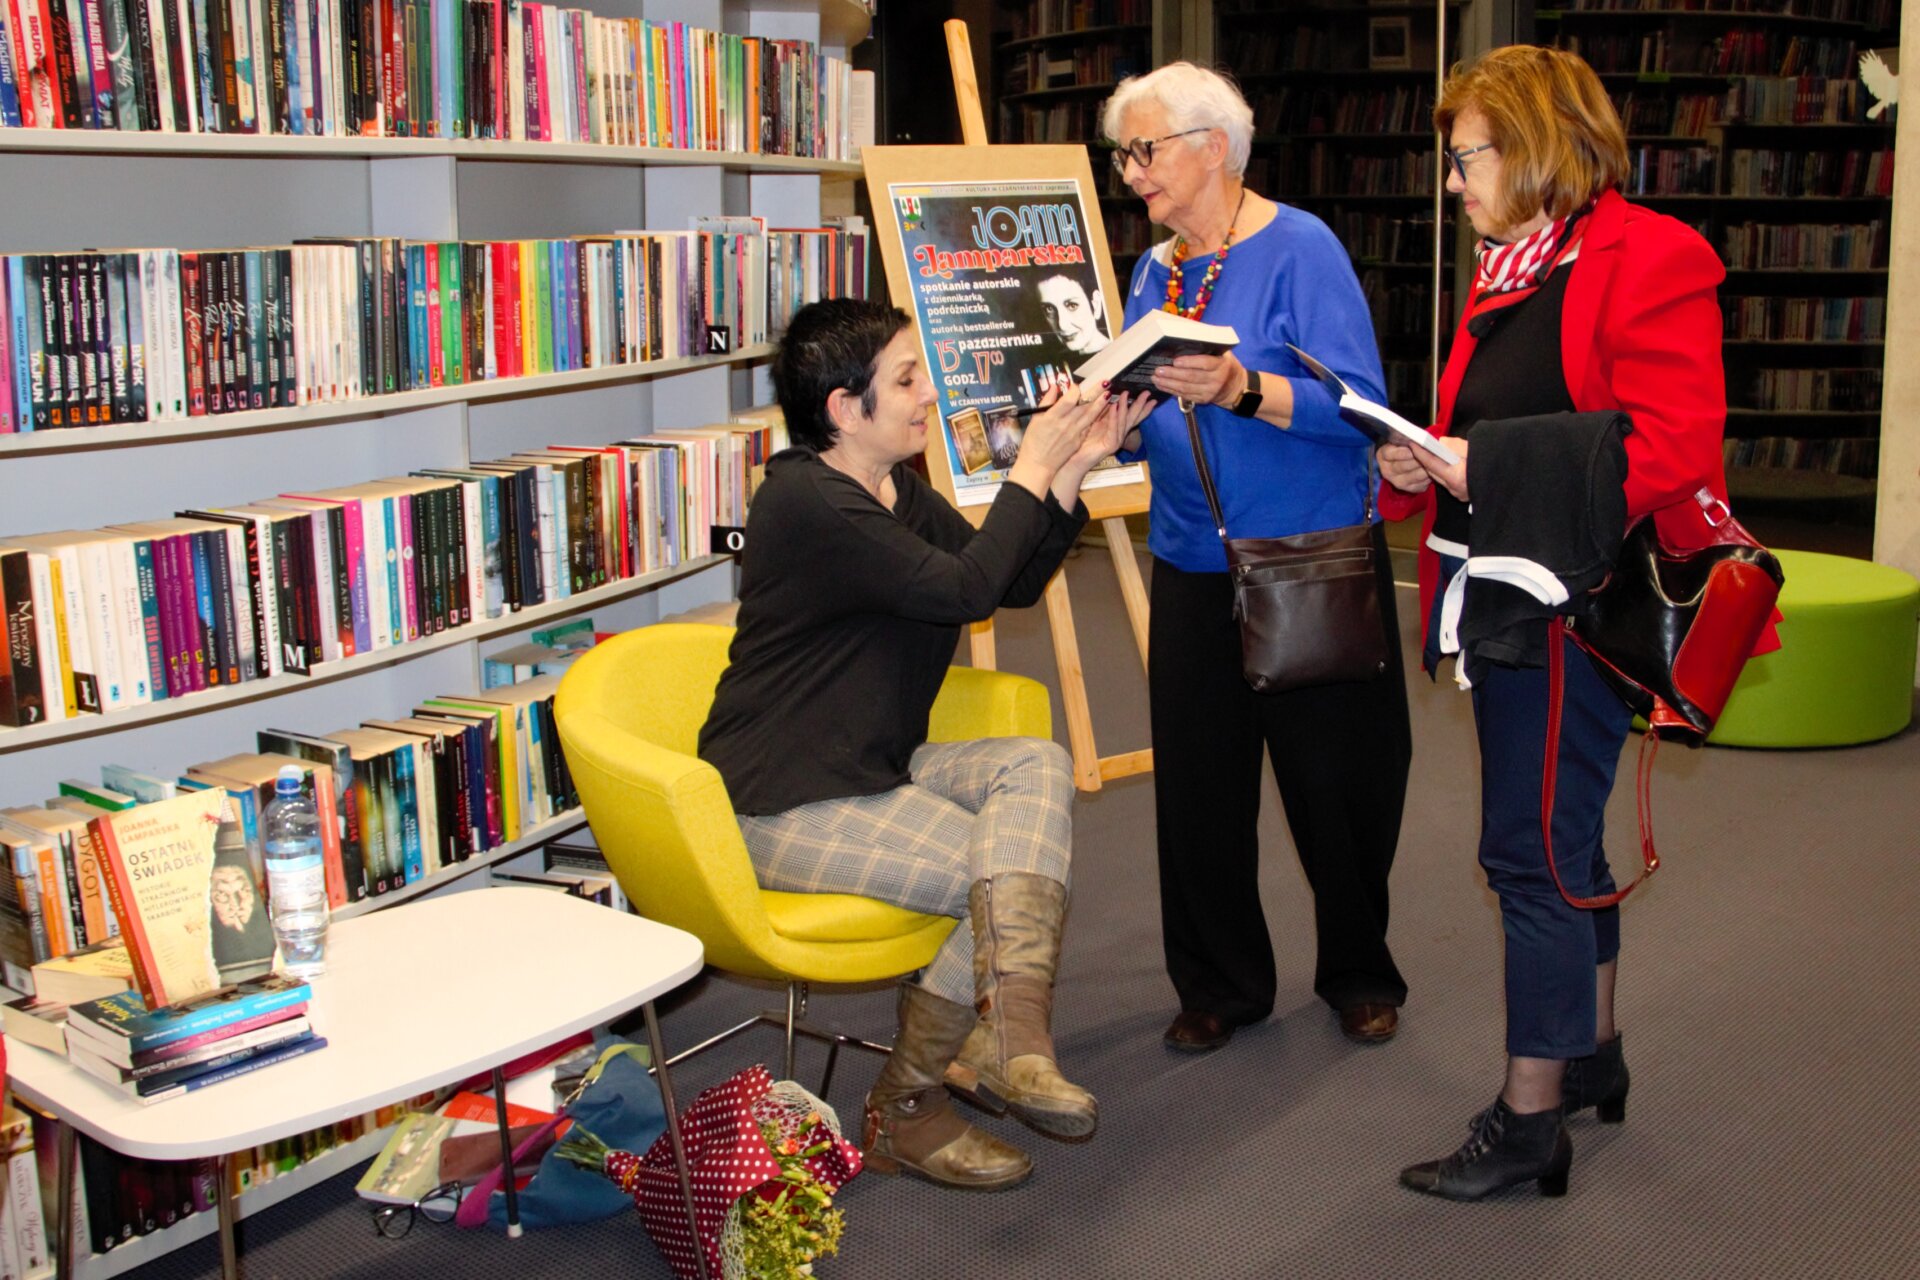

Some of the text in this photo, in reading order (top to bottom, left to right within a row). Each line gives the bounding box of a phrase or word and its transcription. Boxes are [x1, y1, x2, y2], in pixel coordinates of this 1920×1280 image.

[971, 203, 1081, 249] JOANNA
[920, 277, 1020, 294] spotkanie autorskie
[232, 299, 246, 331] Mars
[513, 300, 521, 347] Szeptucha
[927, 303, 991, 317] podróżniczką
[710, 331, 727, 350] N
[931, 320, 1015, 334] autorką bestsellerów
[132, 344, 145, 386] BŁYSK
[934, 339, 960, 373] 15
[30, 351, 44, 403] TAJFUN
[113, 345, 127, 397] PIORUN
[944, 373, 979, 386] GODZ.
[949, 395, 1013, 407] W CZARNYM BORZE
[726, 531, 745, 551] O
[17, 600, 34, 668] Mroczny
[144, 615, 159, 643] BOSS
[259, 618, 270, 671] Waldemar
[283, 643, 307, 670] M
[79, 680, 98, 706] L
[119, 818, 159, 835] JOANNA
[121, 823, 181, 845] LAMPARSKA
[128, 838, 194, 866] OSTATNI
[132, 851, 206, 881] ŚWIADEK
[77, 834, 100, 899] DYGOT
